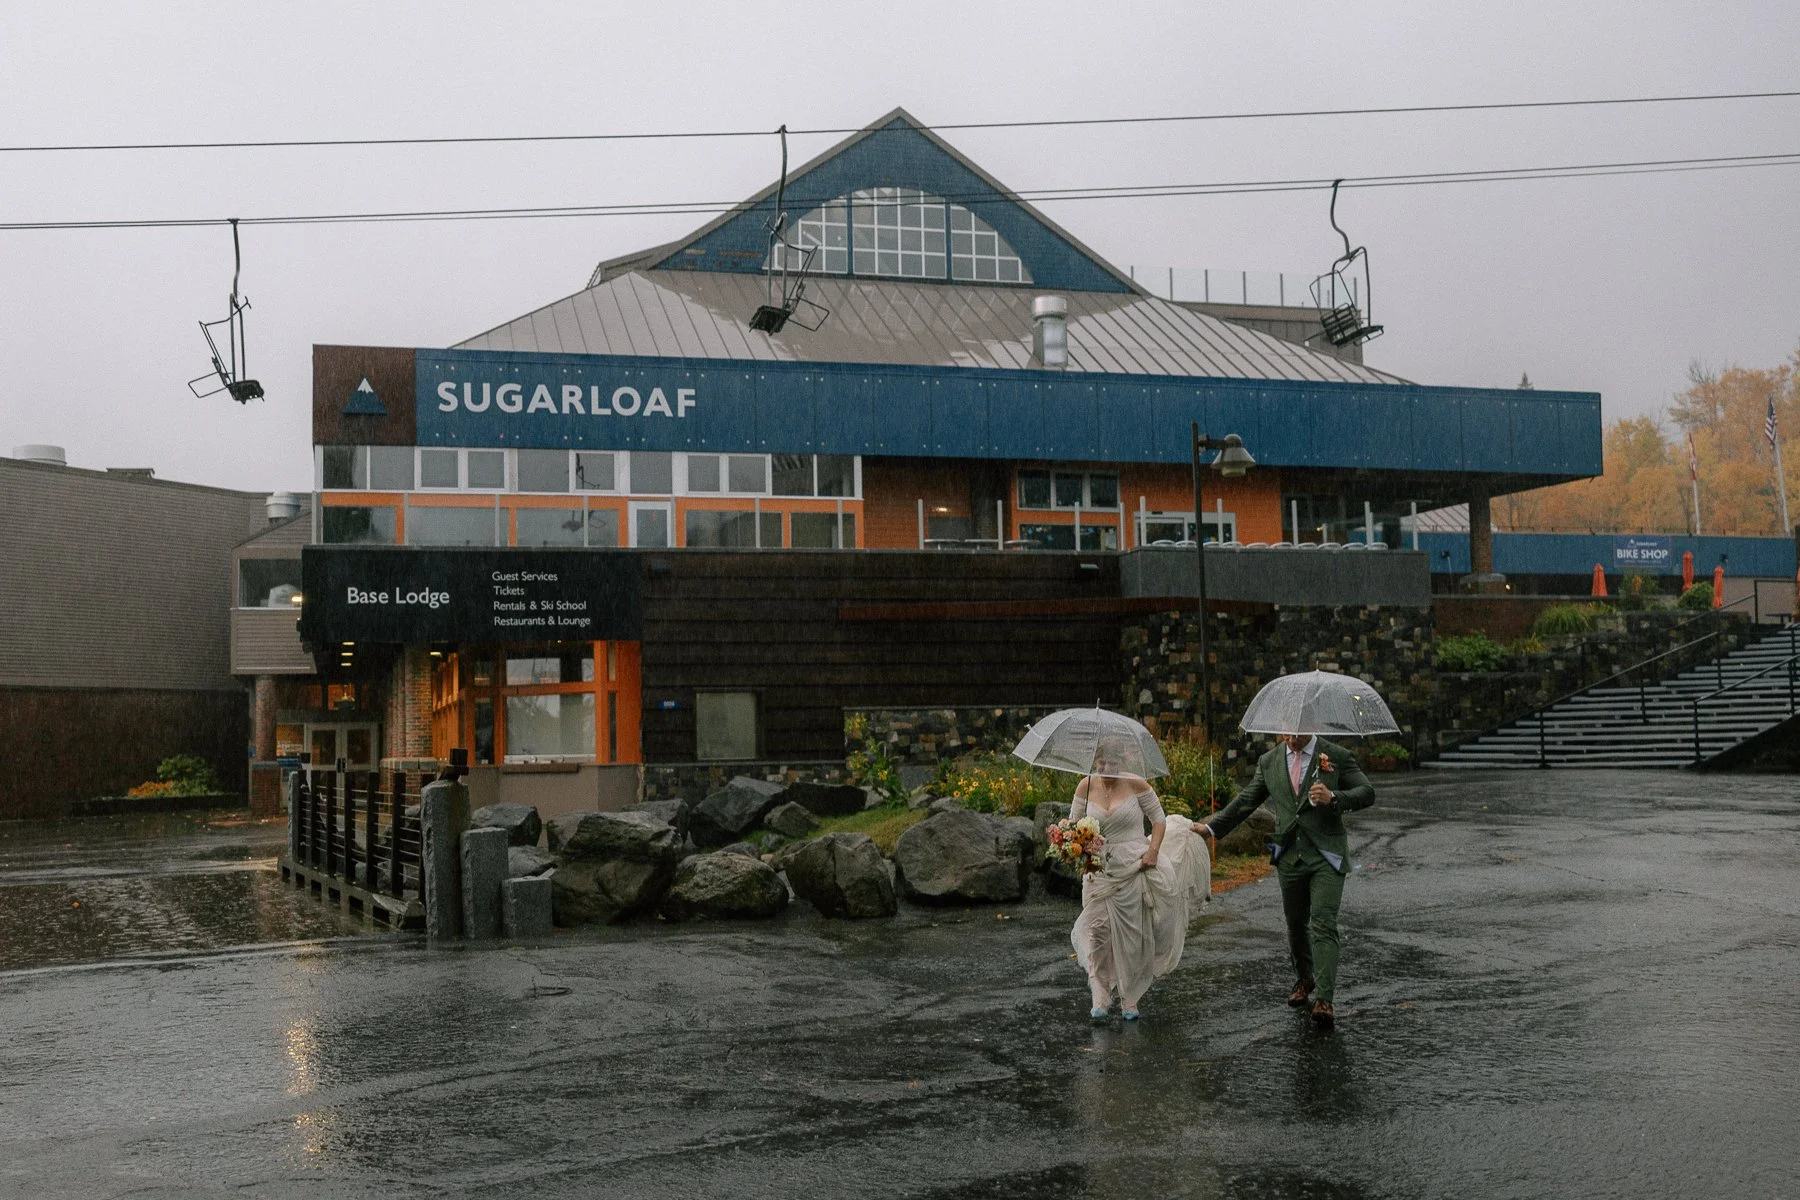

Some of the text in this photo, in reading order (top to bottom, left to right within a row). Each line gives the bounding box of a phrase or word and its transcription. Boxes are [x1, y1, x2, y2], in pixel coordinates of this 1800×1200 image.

[436, 381, 696, 418] SUGARLOAF
[1616, 549, 1668, 559] BIKE SHOP
[491, 571, 558, 581] Guest Services
[493, 585, 525, 596] Tickets
[347, 587, 450, 609] Base Lodge
[493, 600, 587, 611] Rentals & Ski School
[494, 615, 591, 628] Restaurants & Lounge
